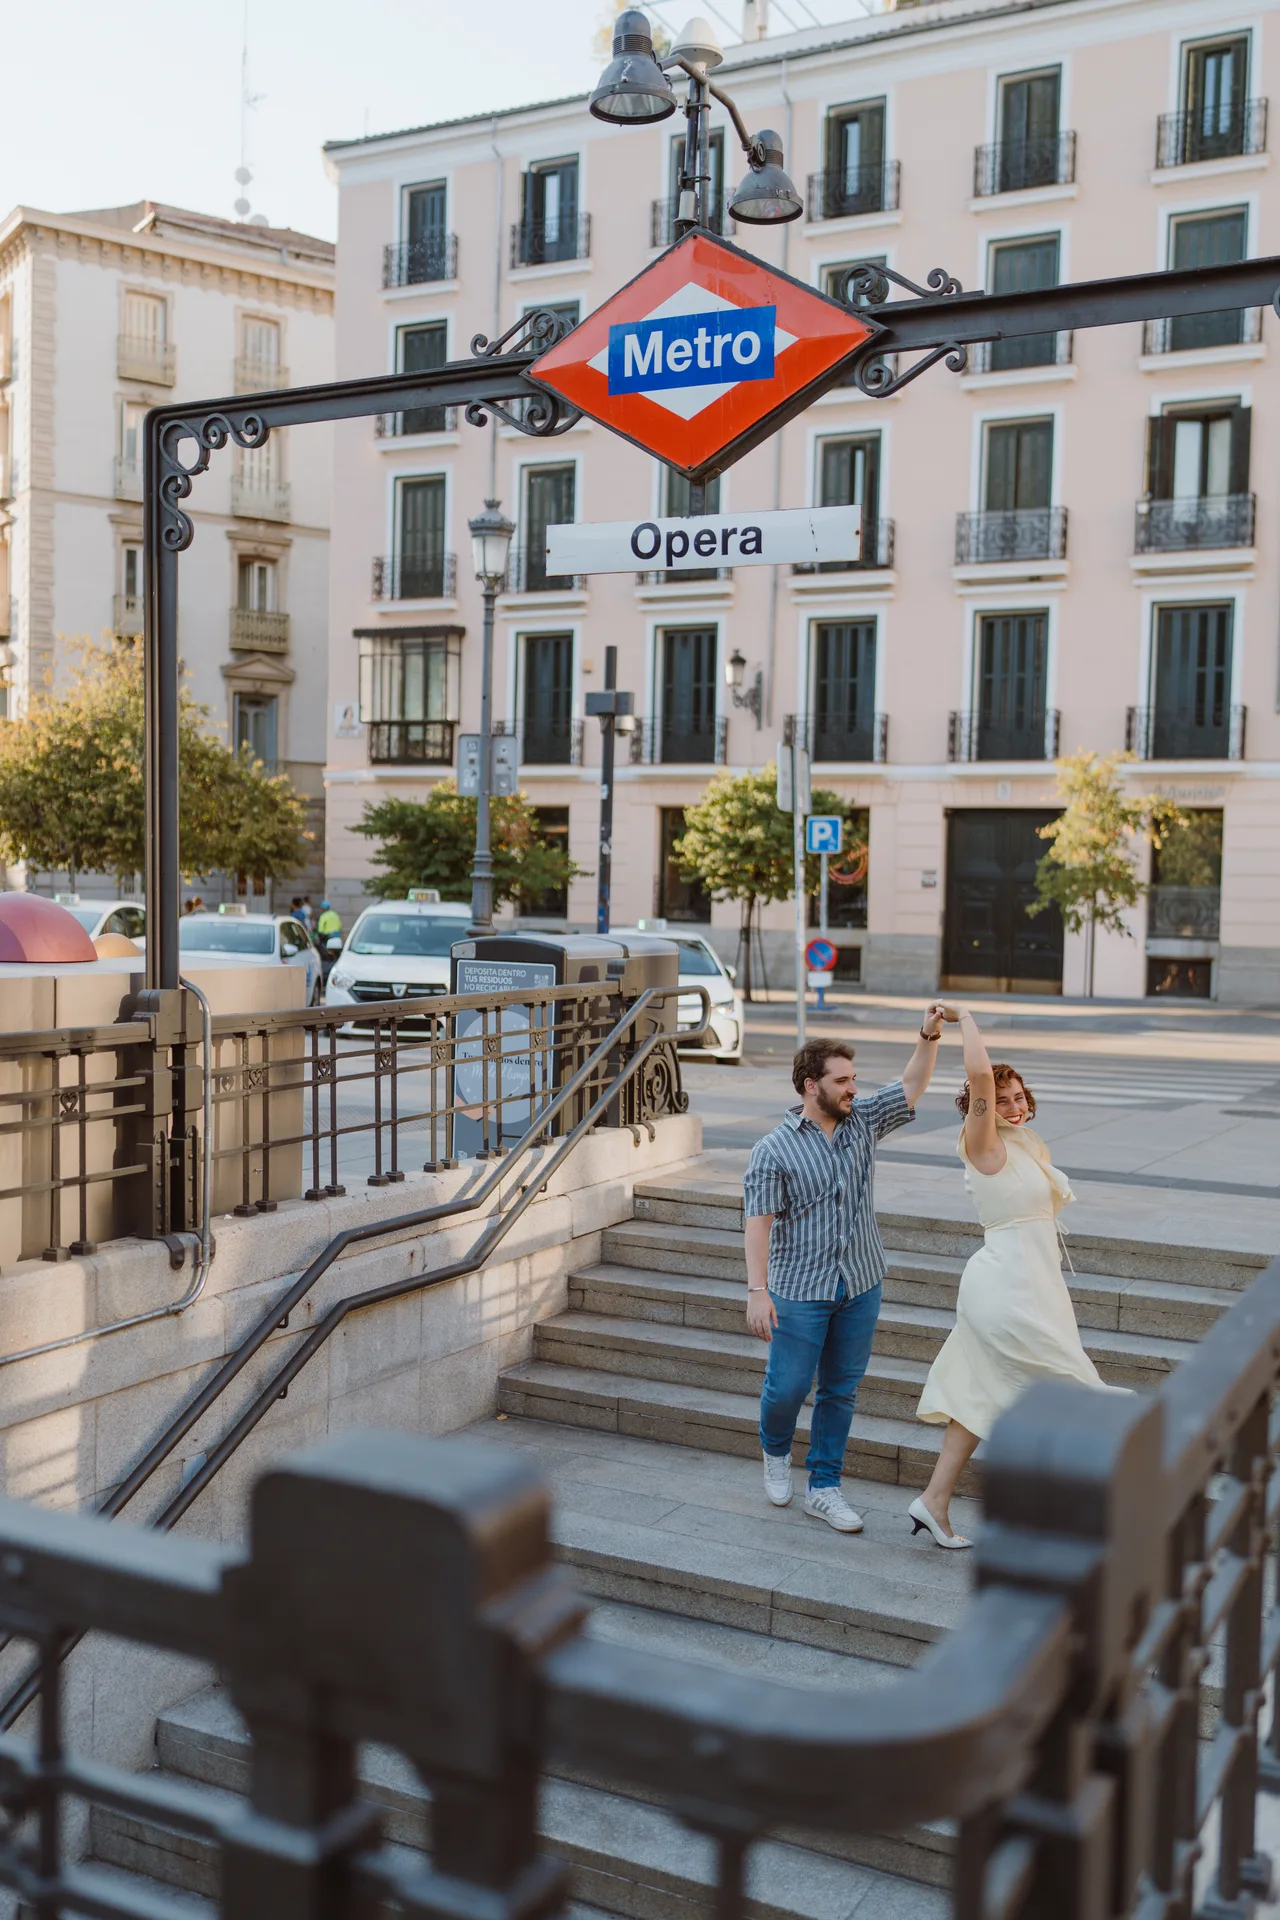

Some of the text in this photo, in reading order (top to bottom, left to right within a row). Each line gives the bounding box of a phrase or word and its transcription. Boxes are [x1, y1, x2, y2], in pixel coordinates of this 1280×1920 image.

[624, 327, 761, 378] Metro
[631, 522, 763, 567] Opera
[812, 822, 832, 848] P
[464, 967, 527, 978] DEPOSITA DENTRO
[464, 975, 513, 985] TUS RESIDUOS
[464, 983, 475, 991] NO
[515, 1056, 543, 1067] denro
